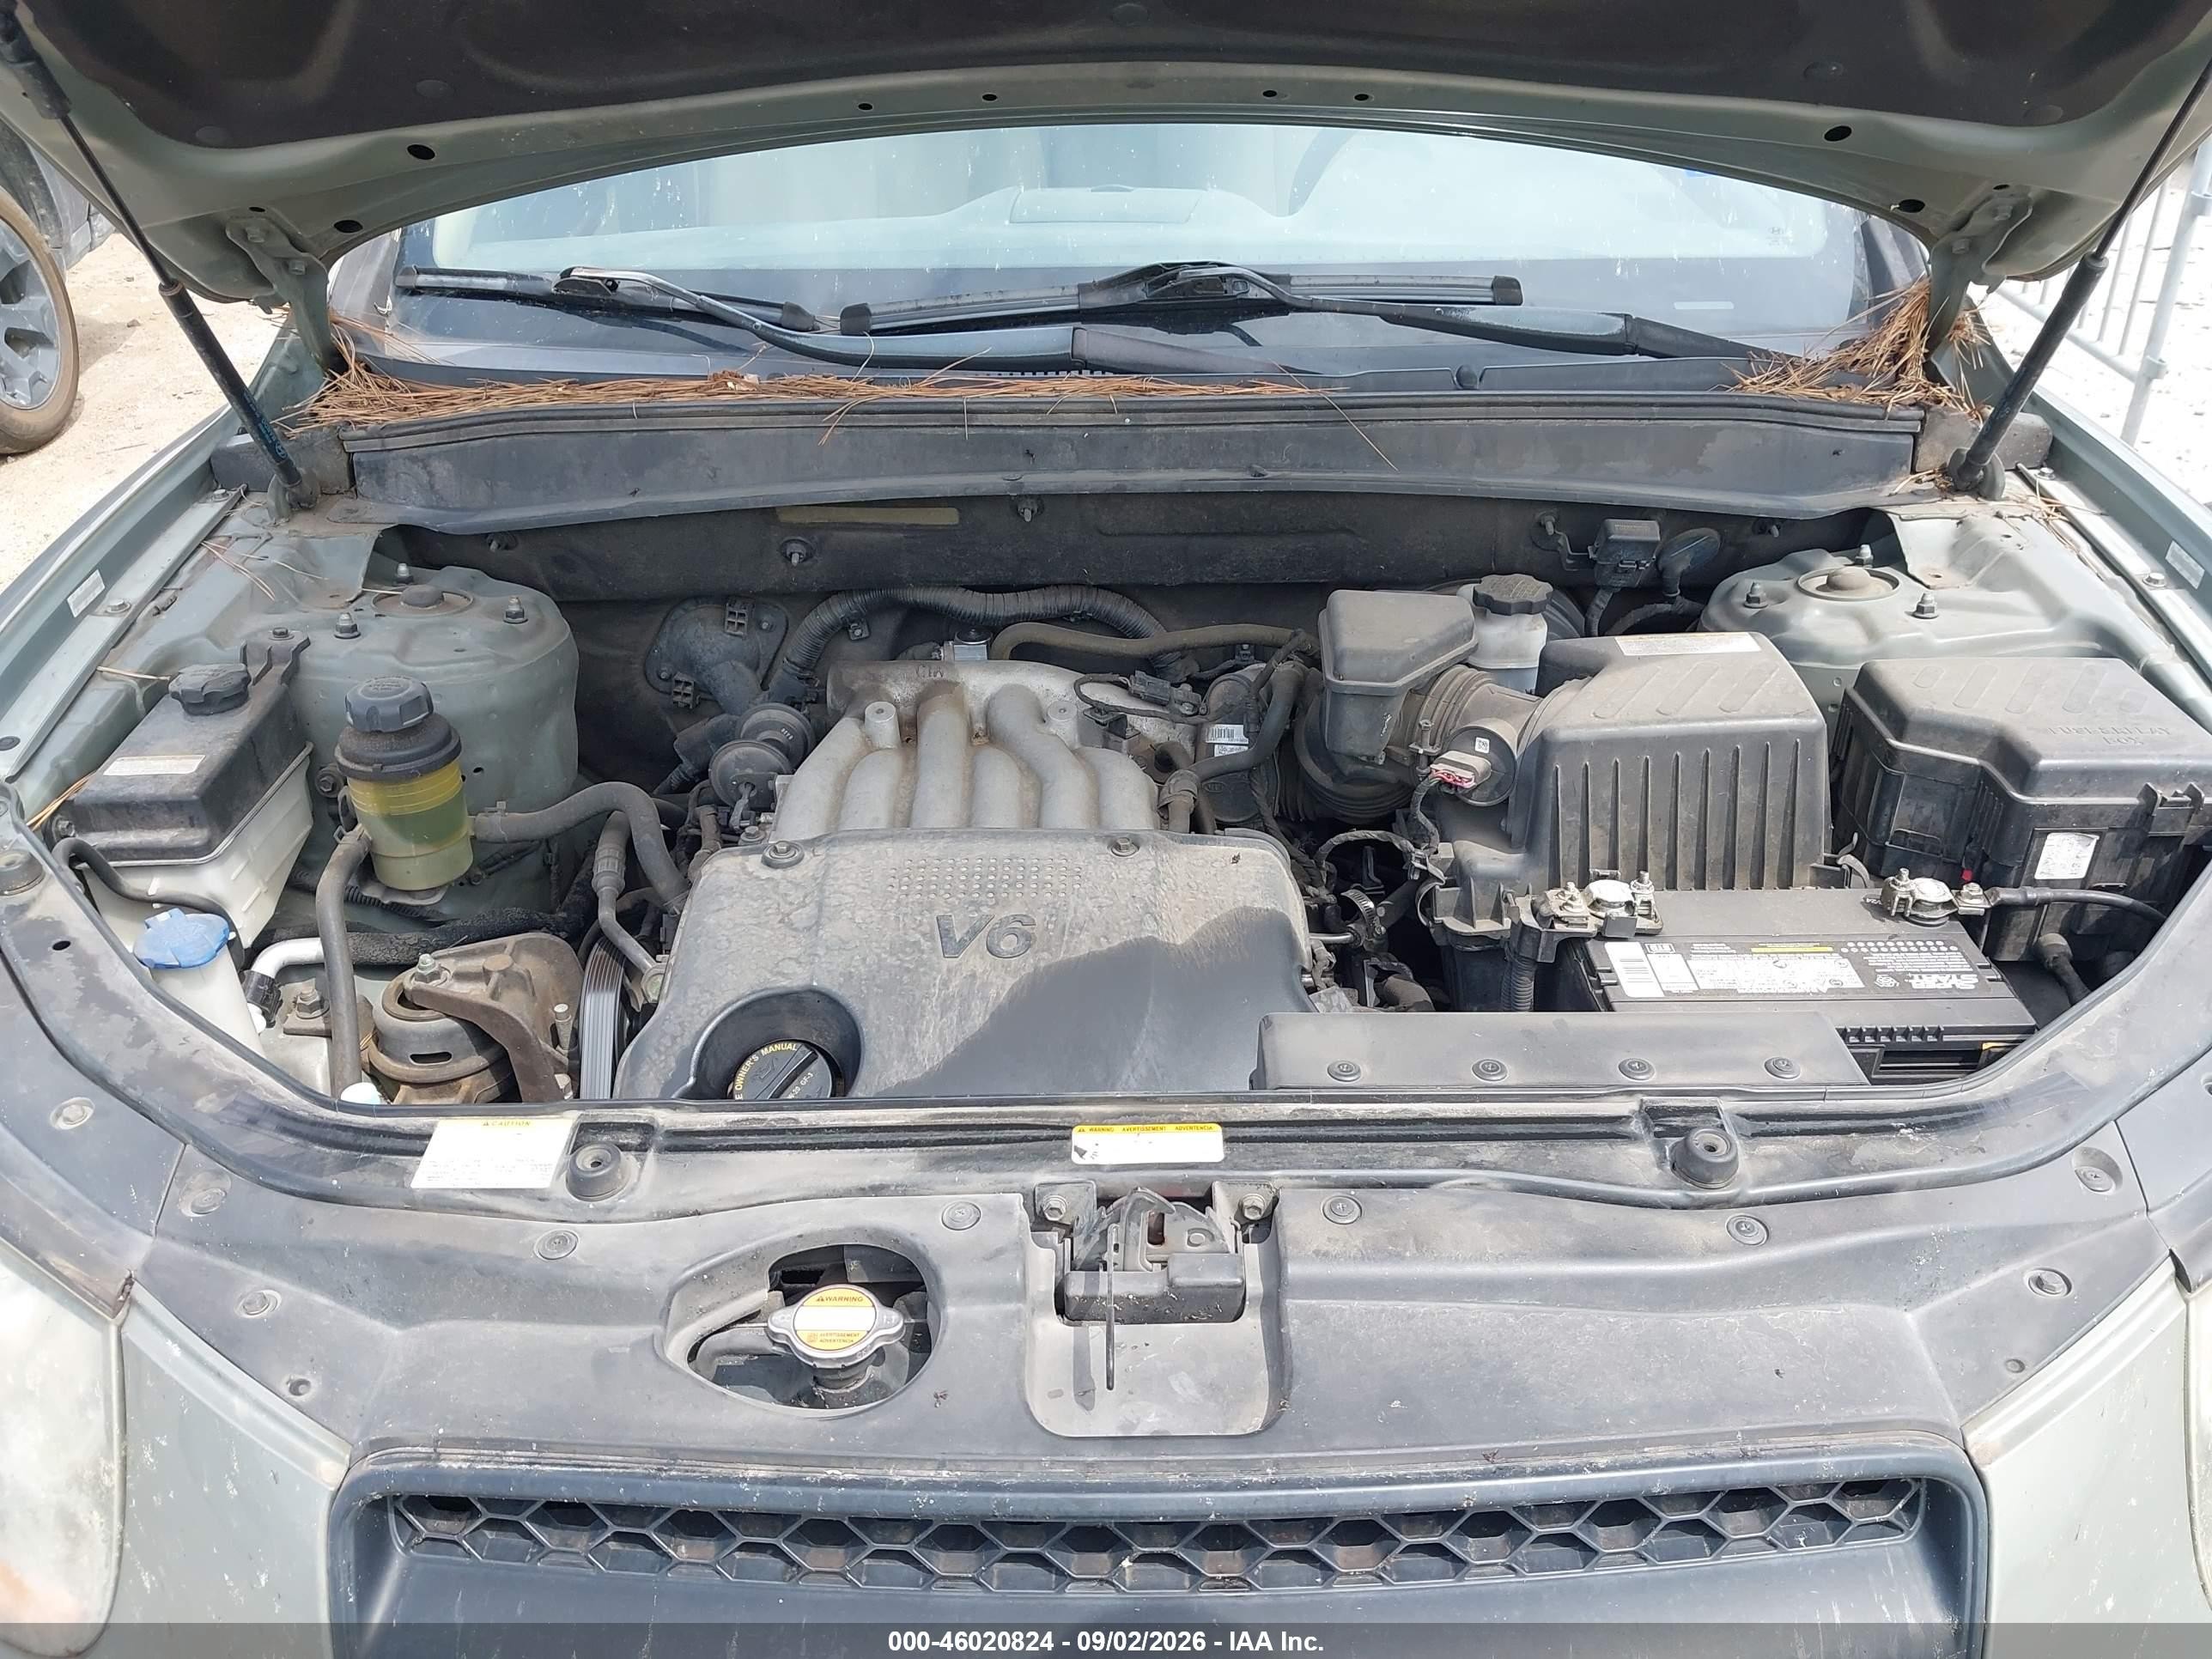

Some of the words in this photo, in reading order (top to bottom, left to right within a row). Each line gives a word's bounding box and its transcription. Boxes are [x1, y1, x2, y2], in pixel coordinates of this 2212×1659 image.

[936, 914, 1037, 958] V6
[734, 1054, 760, 1091] OWNER'S
[761, 1042, 798, 1057] MANUAL
